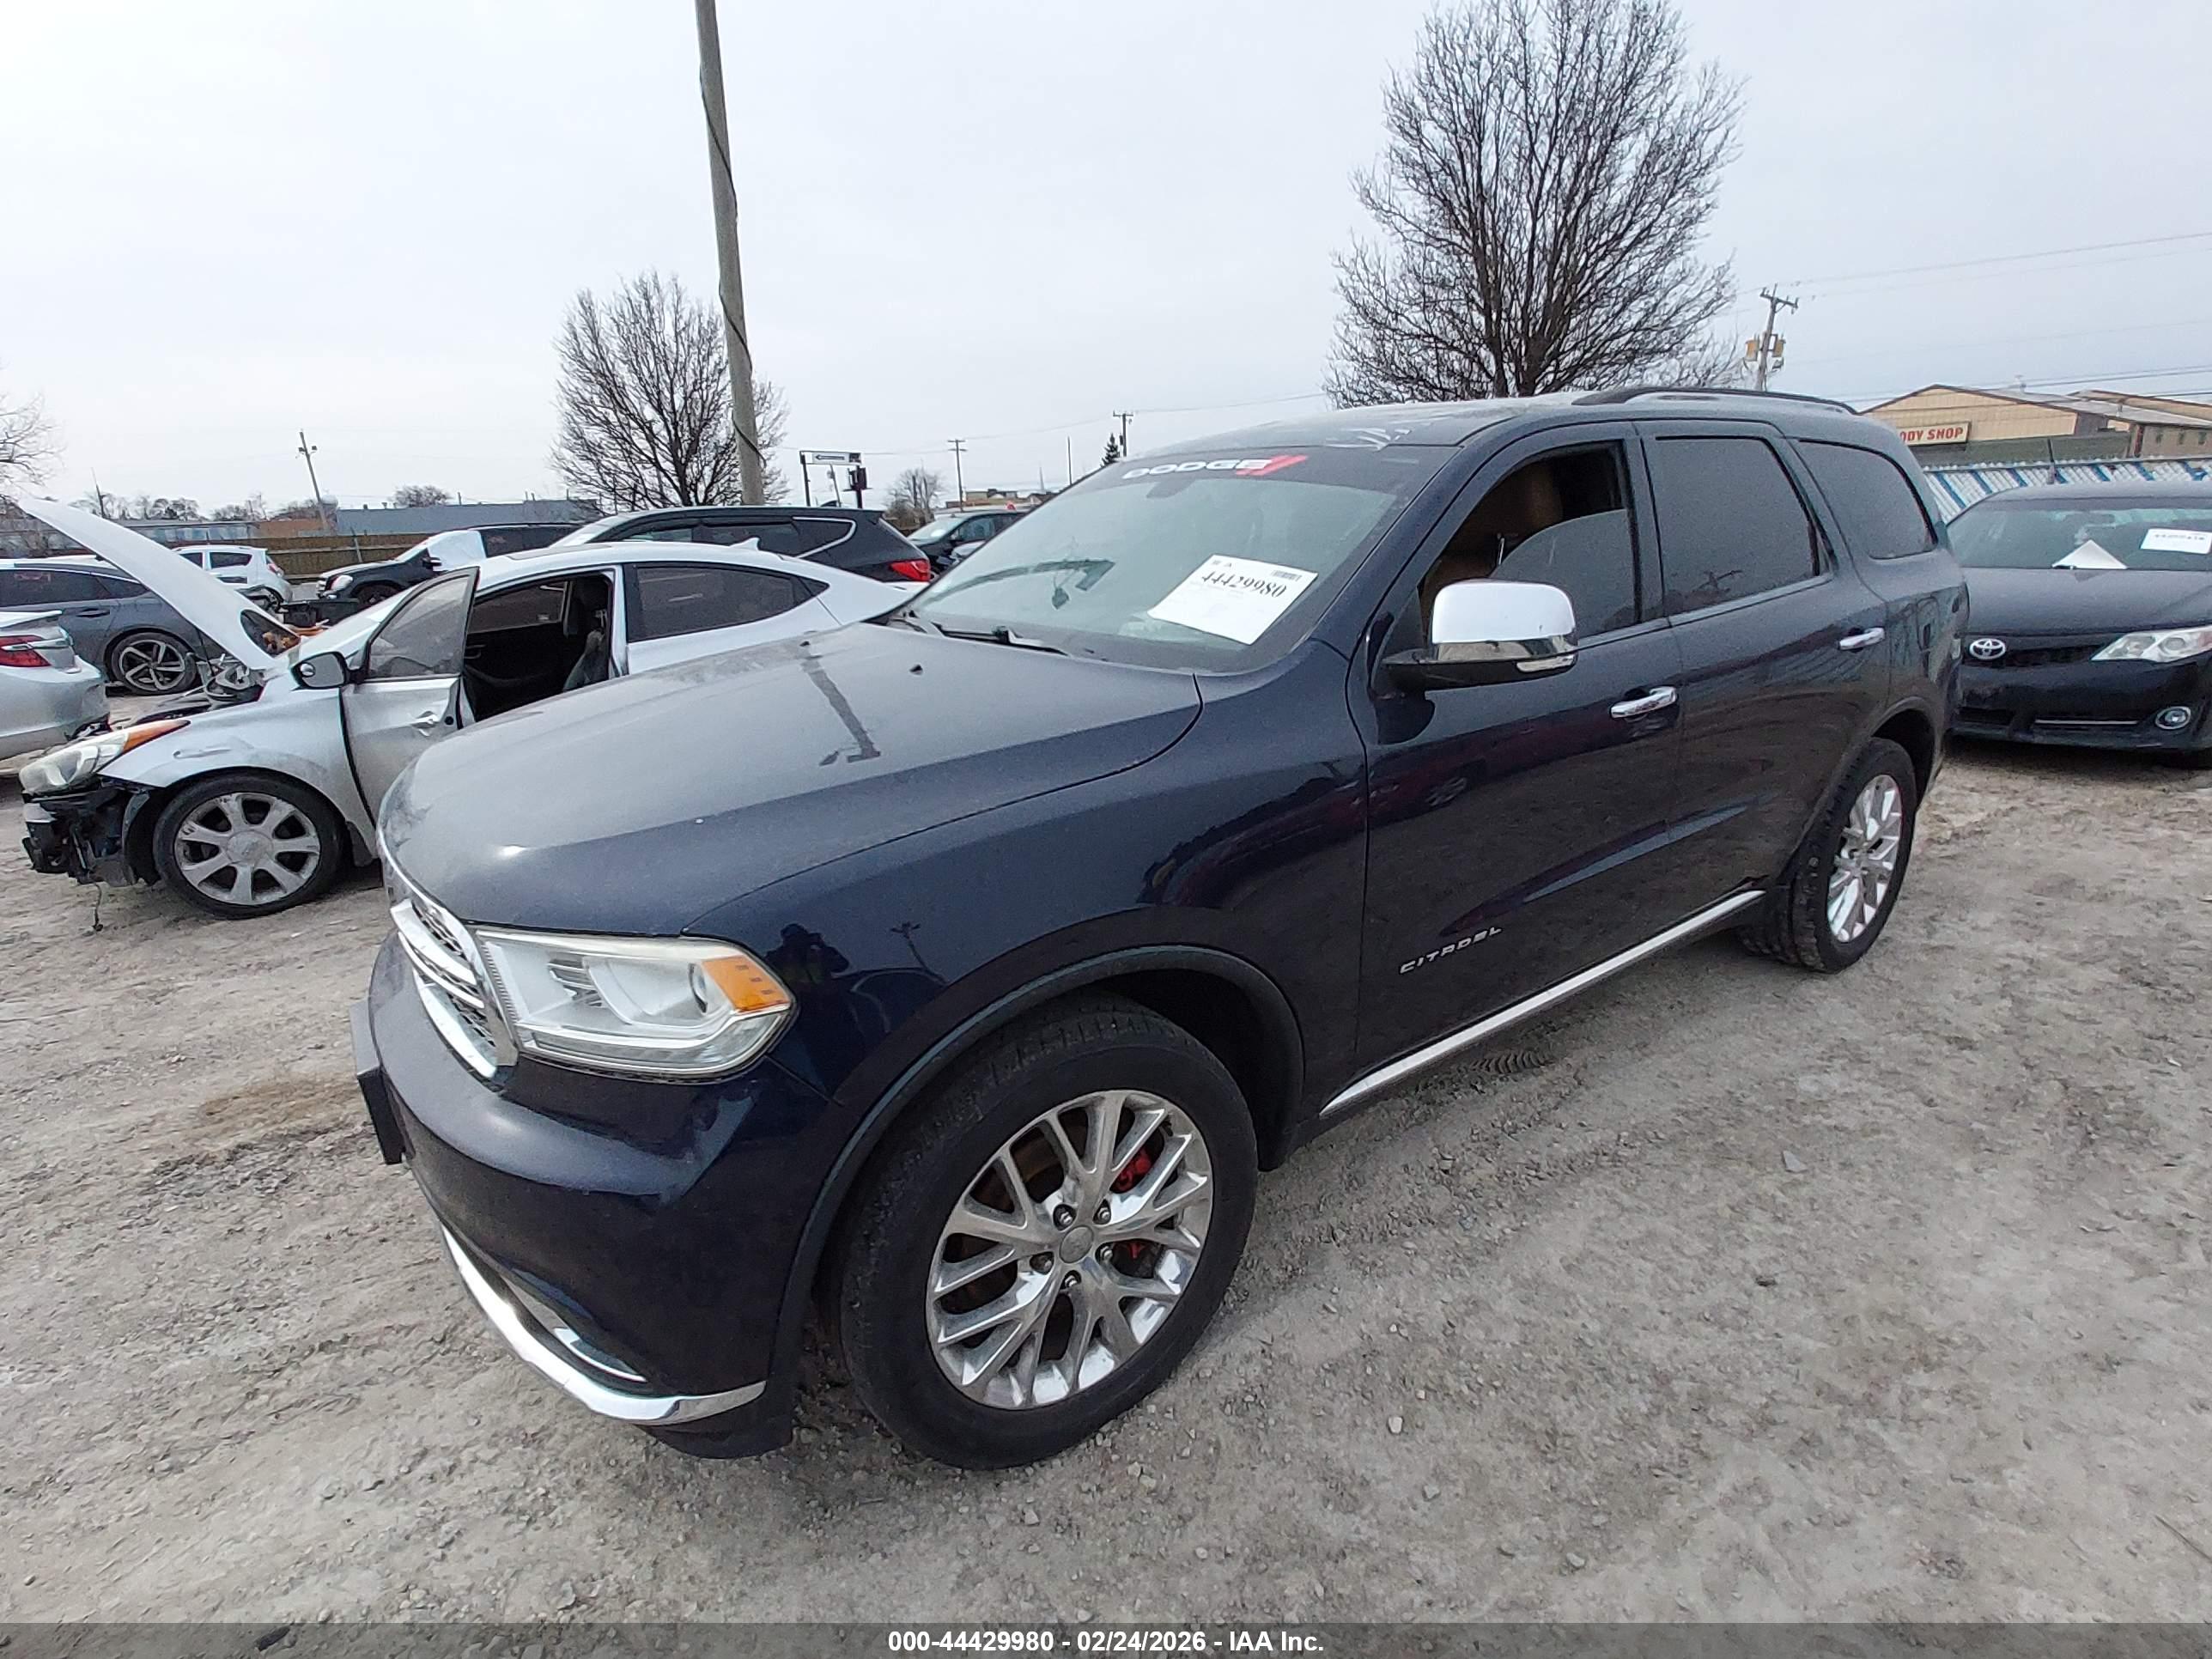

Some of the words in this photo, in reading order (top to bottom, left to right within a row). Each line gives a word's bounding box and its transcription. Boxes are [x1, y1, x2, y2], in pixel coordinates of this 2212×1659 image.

[1899, 430, 1923, 441] ODY
[1927, 427, 1964, 440] SHOP
[1121, 459, 1272, 479] DODGE
[1201, 570, 1287, 599] 44429980
